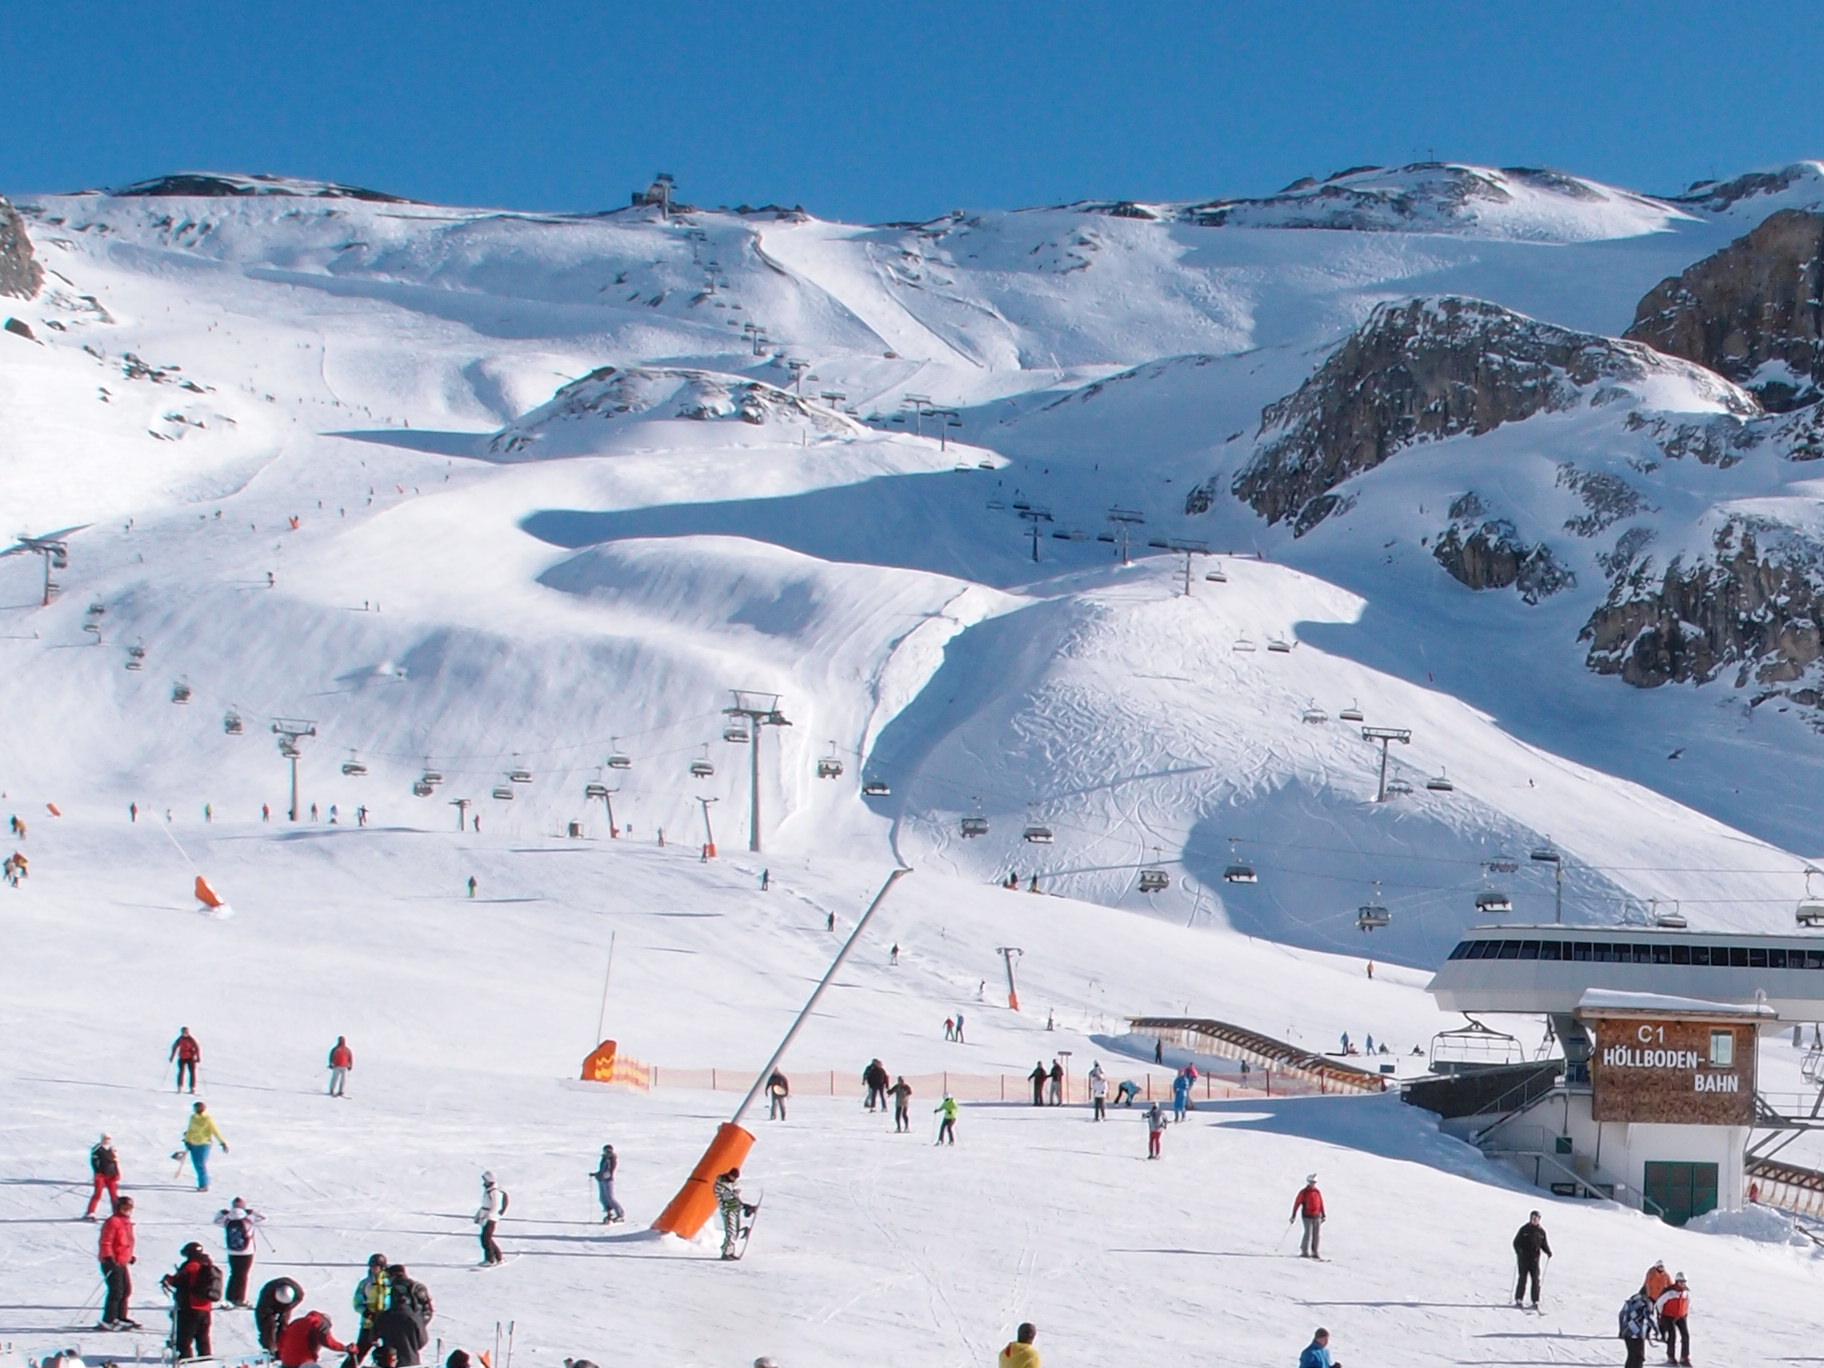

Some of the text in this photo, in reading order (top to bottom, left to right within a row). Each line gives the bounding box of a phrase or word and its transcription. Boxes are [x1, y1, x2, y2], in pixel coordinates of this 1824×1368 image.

[1638, 1025, 1665, 1044] C1
[1603, 1045, 1705, 1069] HÖLLBODEN-
[1694, 1074, 1739, 1093] BAHN
